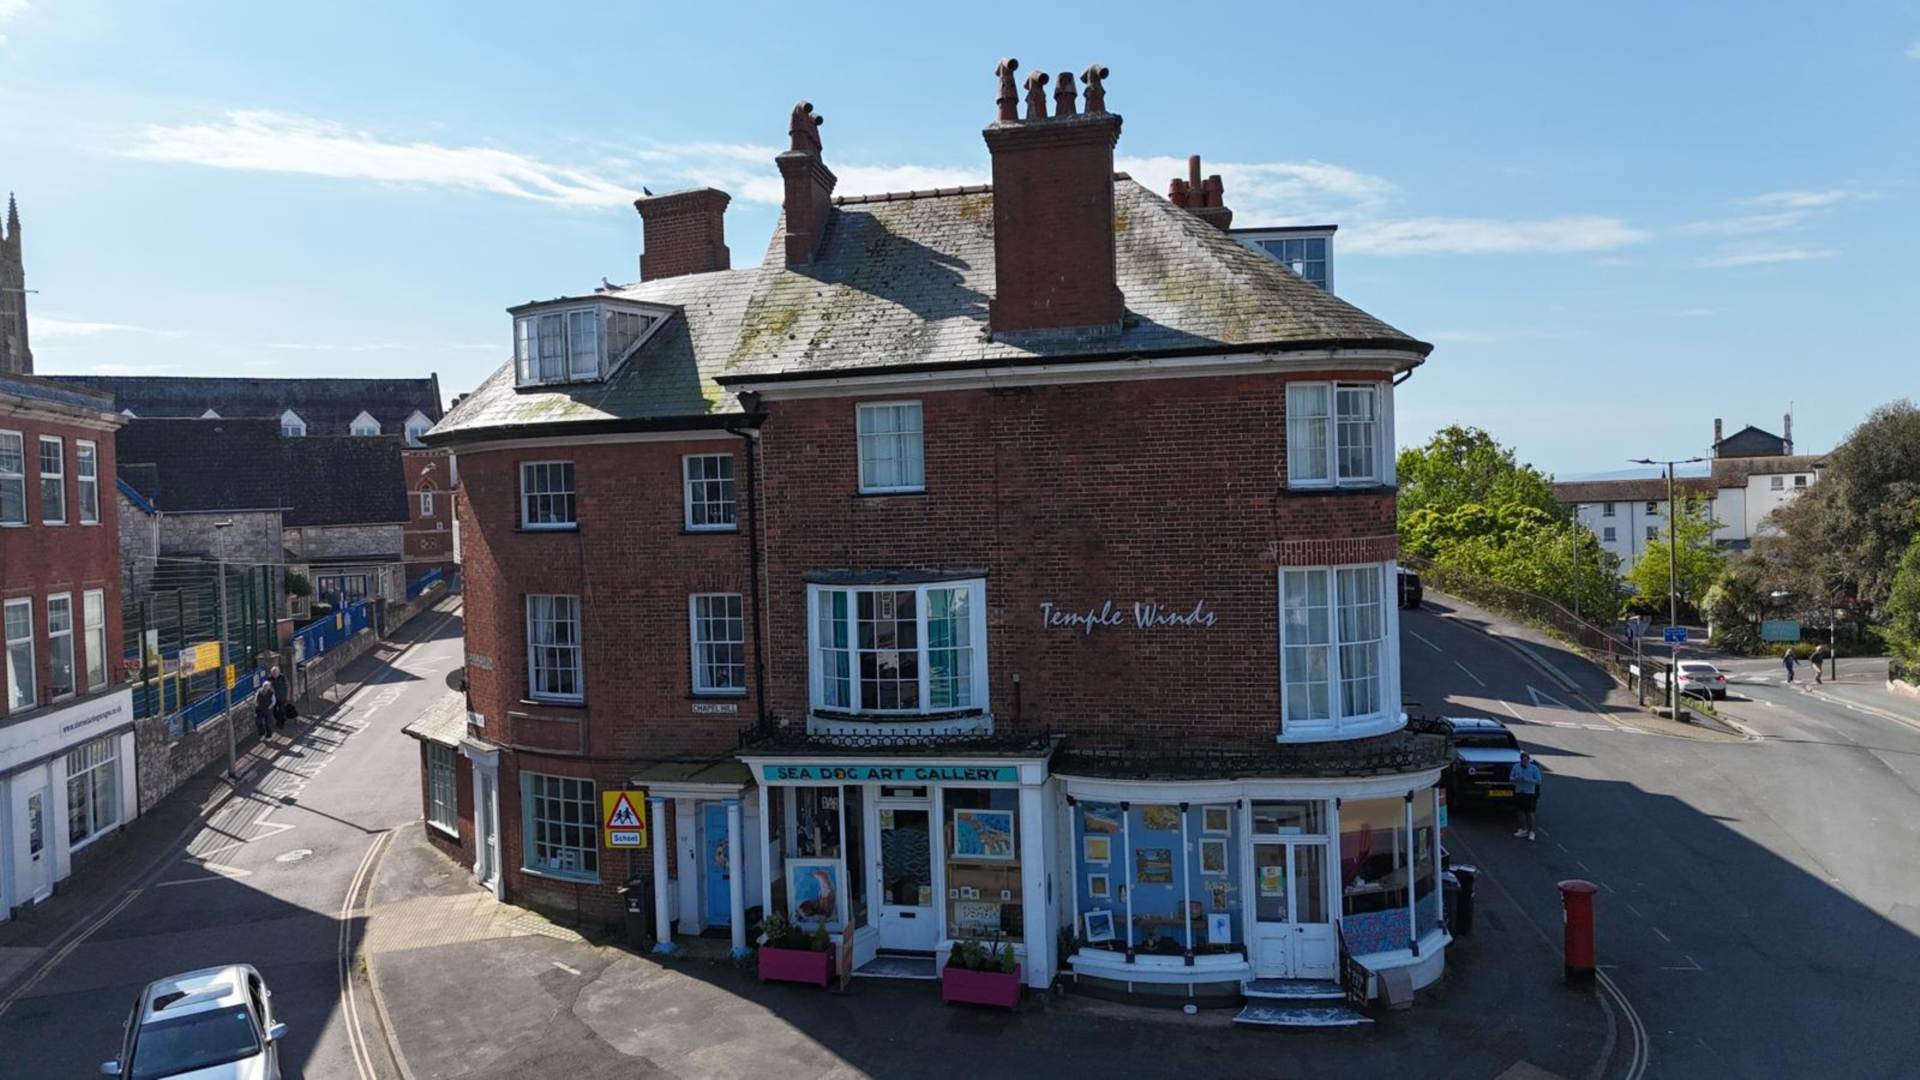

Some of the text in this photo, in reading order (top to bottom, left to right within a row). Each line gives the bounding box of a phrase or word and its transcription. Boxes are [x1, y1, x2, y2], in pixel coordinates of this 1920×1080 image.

[1040, 600, 1218, 635] Temple Winds
[777, 767, 1000, 781] SEA DOG ART GALLERY
[613, 834, 638, 842] School
